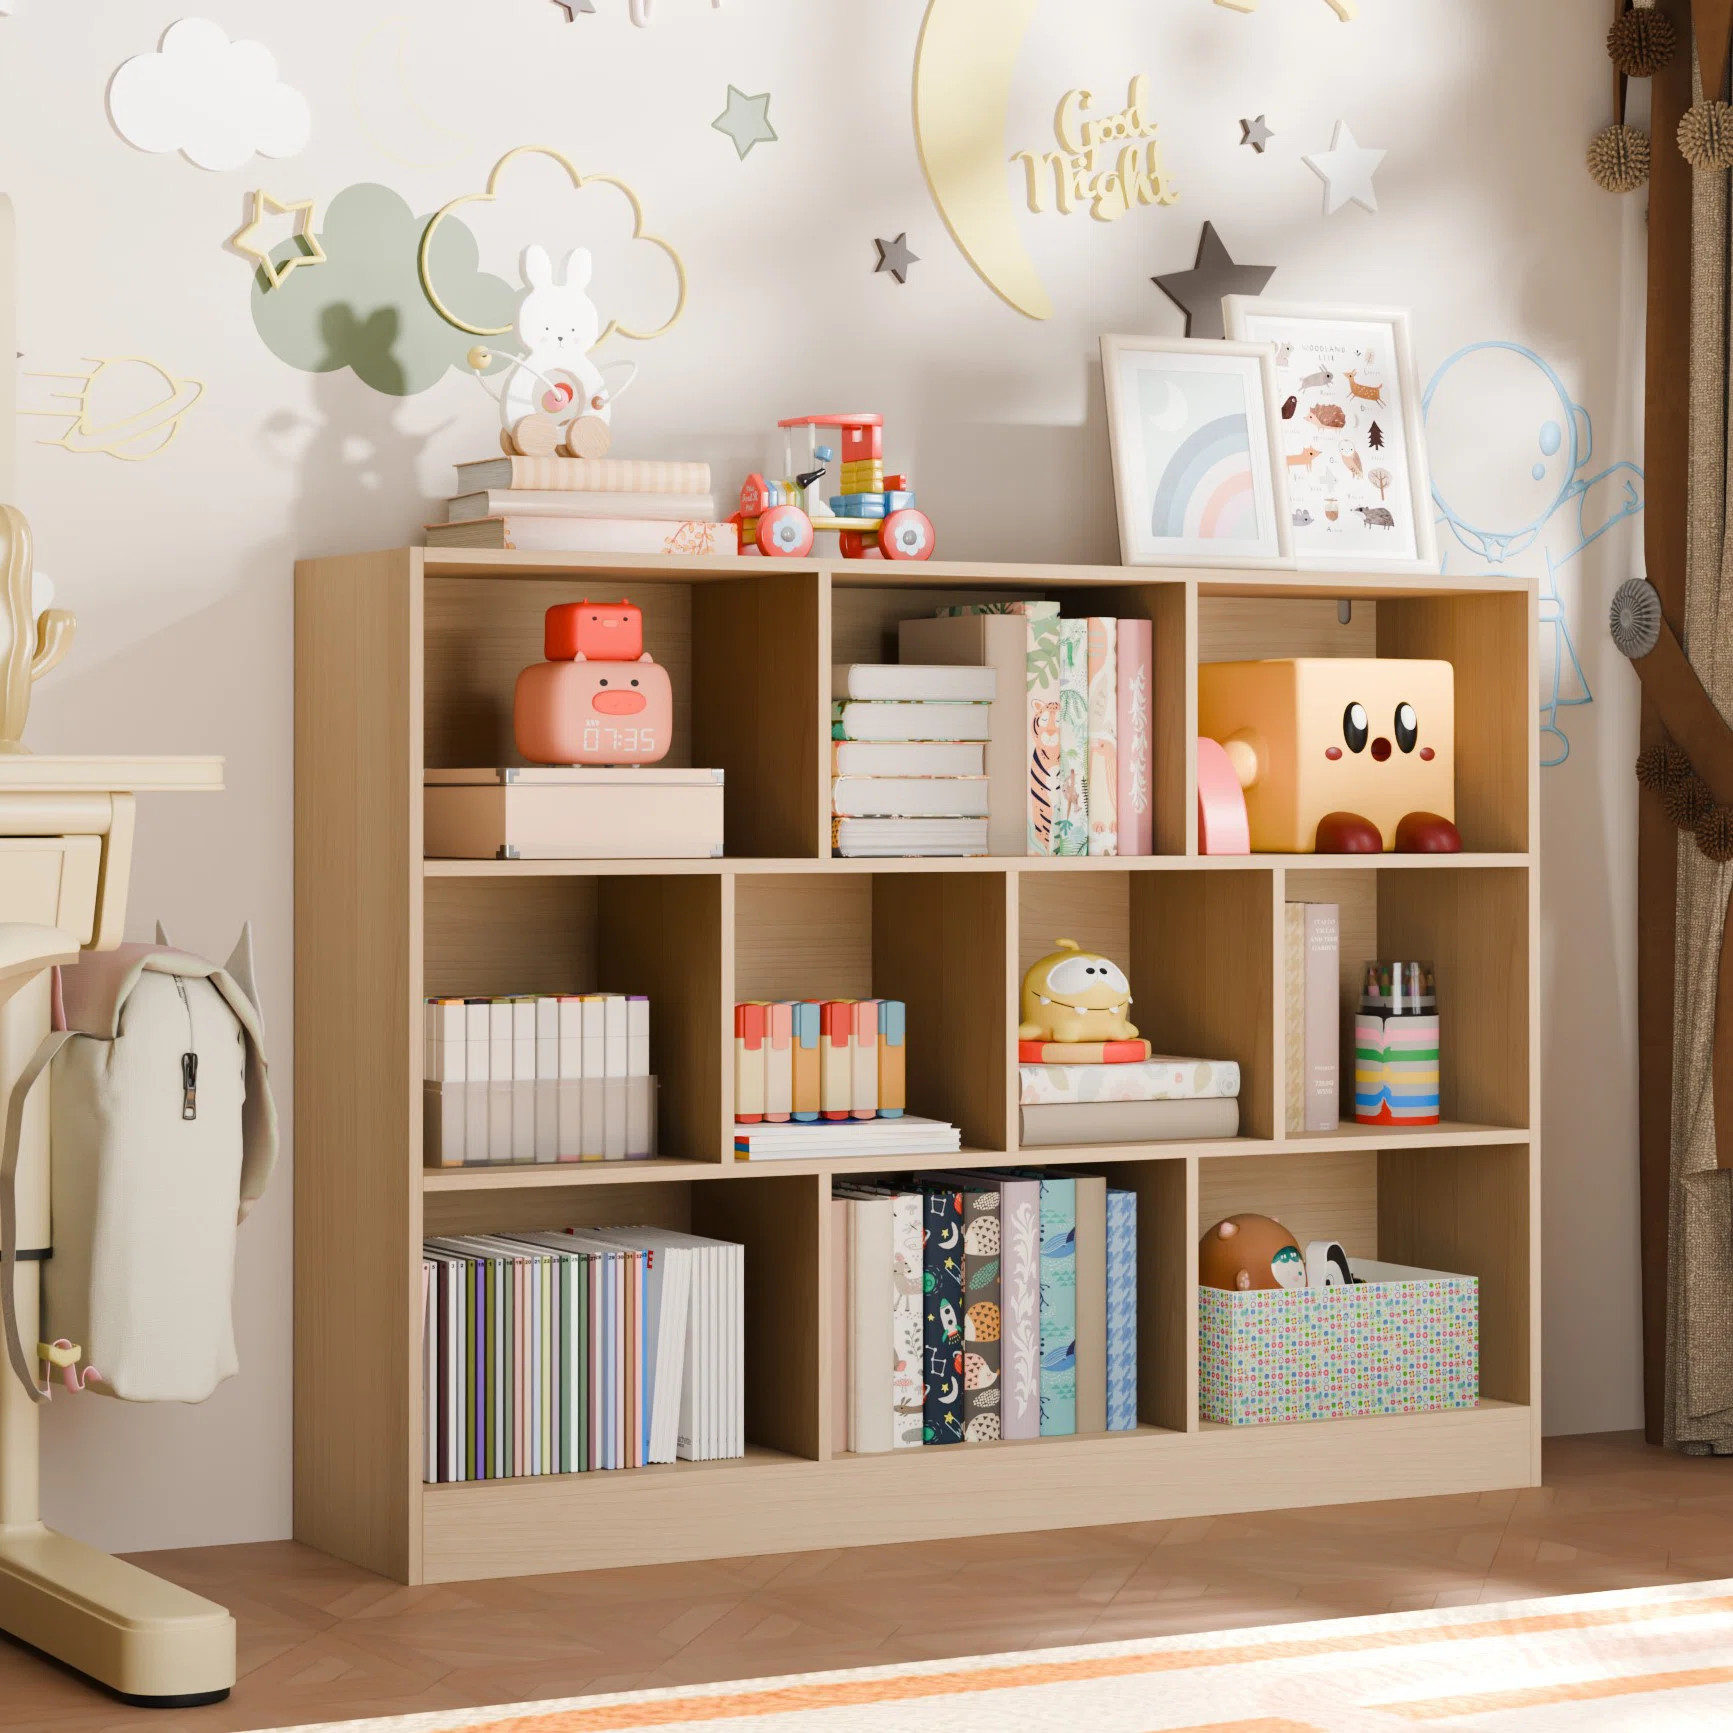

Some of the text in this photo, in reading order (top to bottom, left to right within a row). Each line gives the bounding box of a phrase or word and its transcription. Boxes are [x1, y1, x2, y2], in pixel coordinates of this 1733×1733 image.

[1053, 74, 1158, 171] Good
[1008, 140, 1181, 222] Night
[583, 728, 655, 752] 07:35
